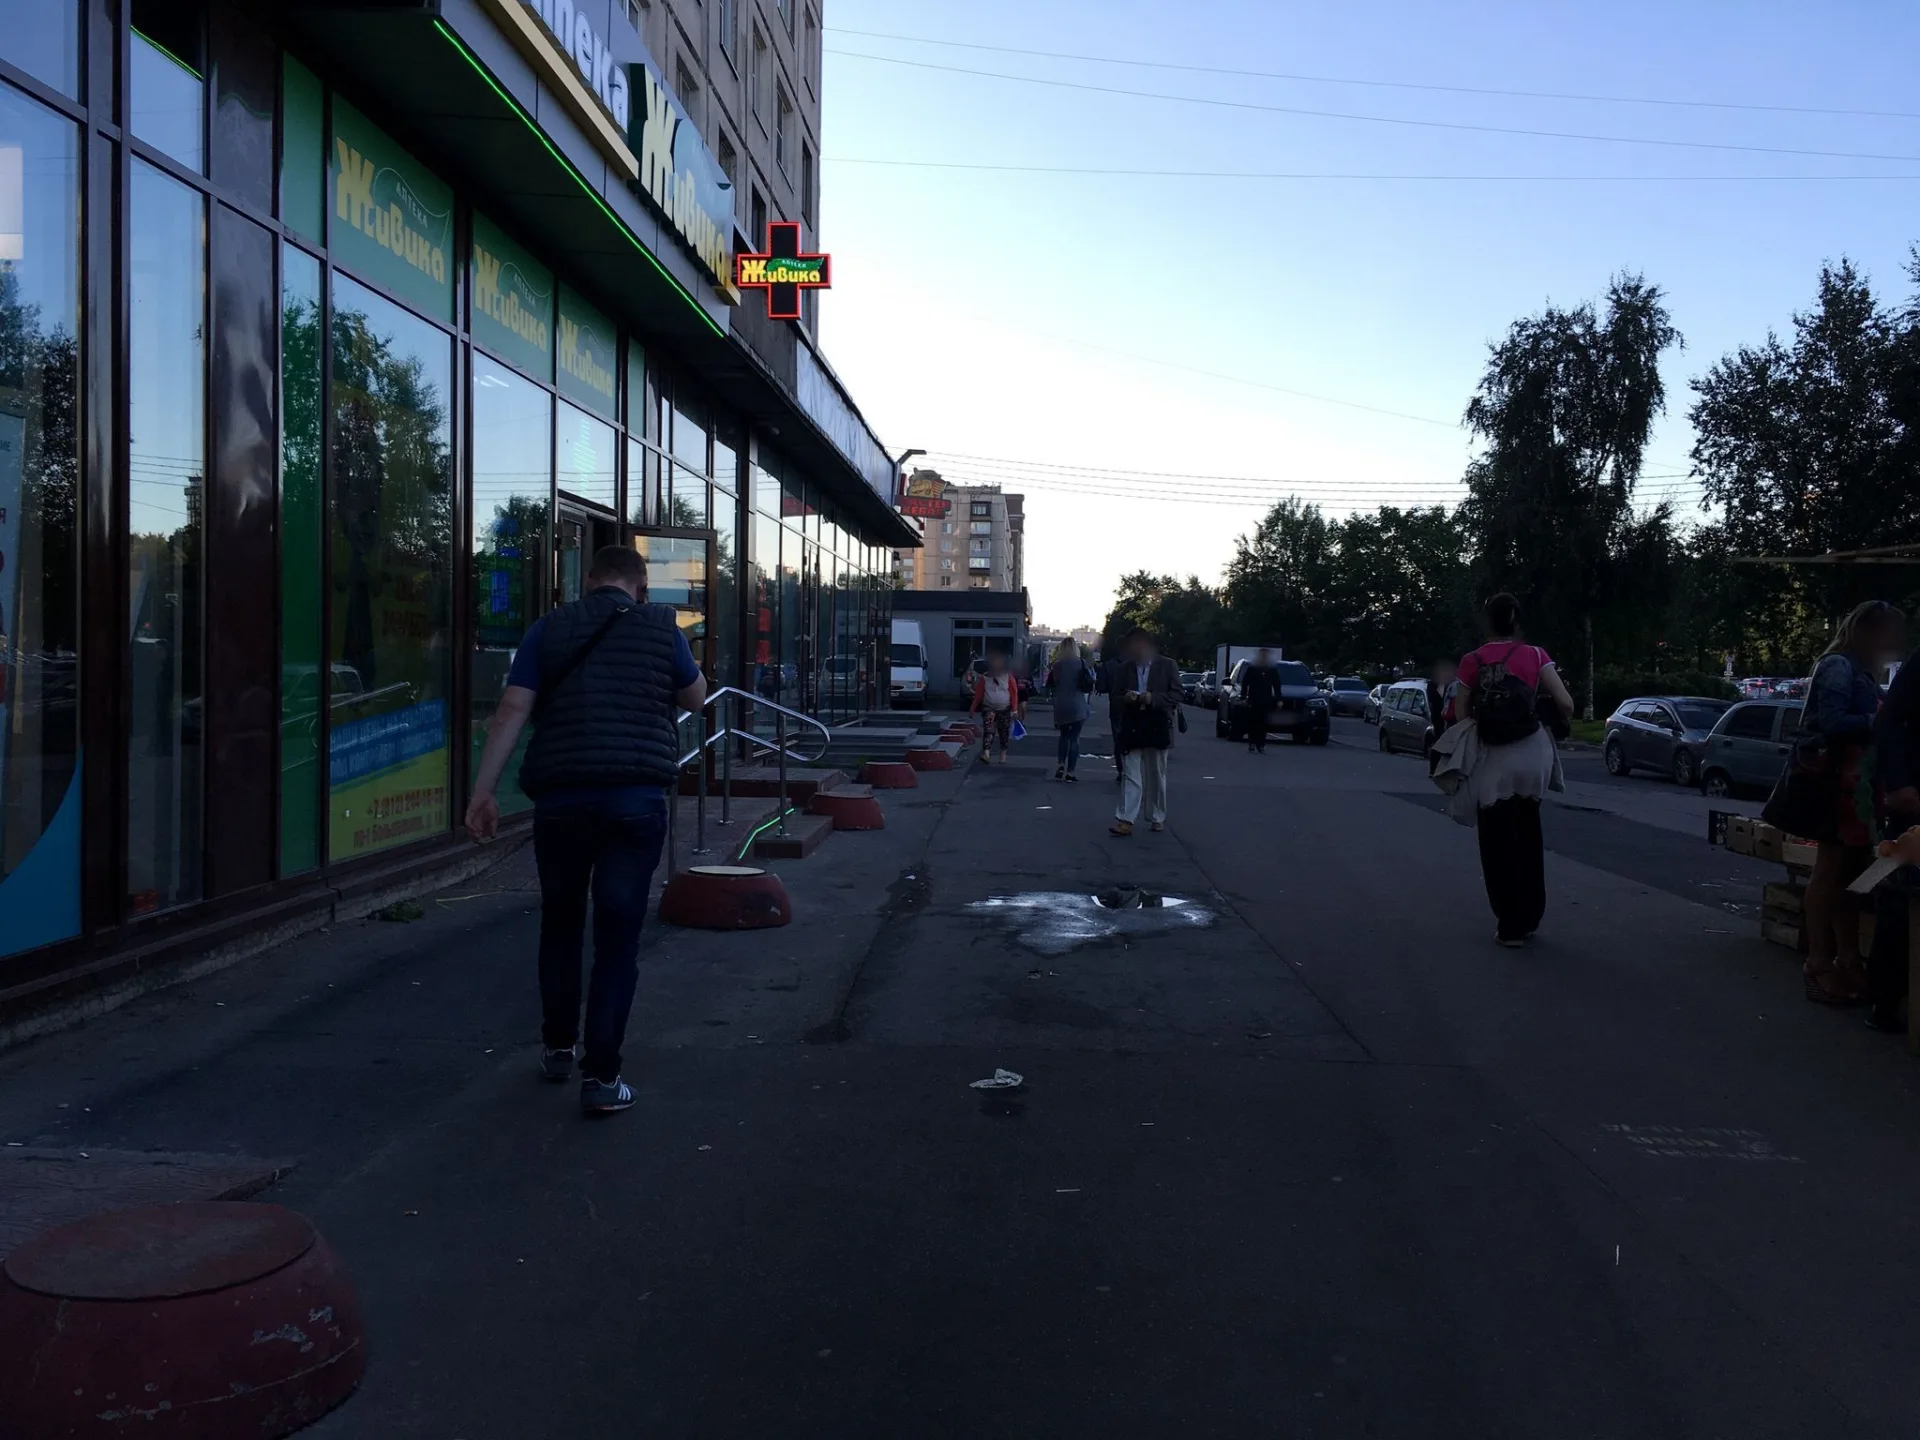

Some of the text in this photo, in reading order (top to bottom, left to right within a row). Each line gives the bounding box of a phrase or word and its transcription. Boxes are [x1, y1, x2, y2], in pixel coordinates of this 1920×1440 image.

[336, 136, 445, 284] Живика
[396, 182, 428, 228] АПТЕКА
[641, 63, 725, 286] Живика
[475, 244, 548, 352] Живика
[742, 260, 821, 283] Живика
[560, 314, 613, 398] Живика
